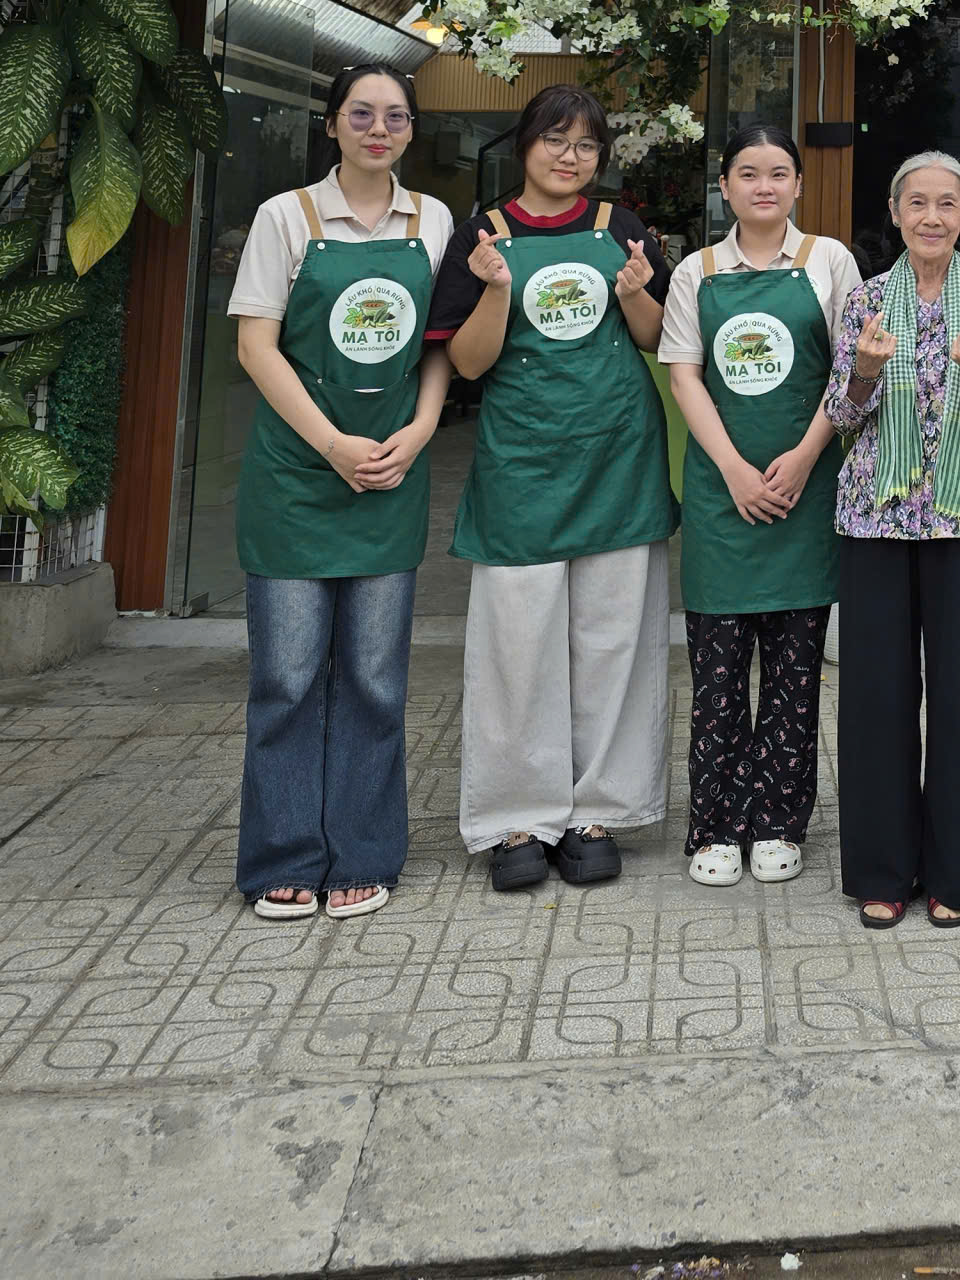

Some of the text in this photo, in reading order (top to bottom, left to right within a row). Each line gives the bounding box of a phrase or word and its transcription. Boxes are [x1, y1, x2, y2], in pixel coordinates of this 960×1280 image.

[540, 303, 596, 324] MẠ TÔI
[342, 327, 400, 345] MẠ TÔI
[726, 359, 781, 377] MẠ TÔI
